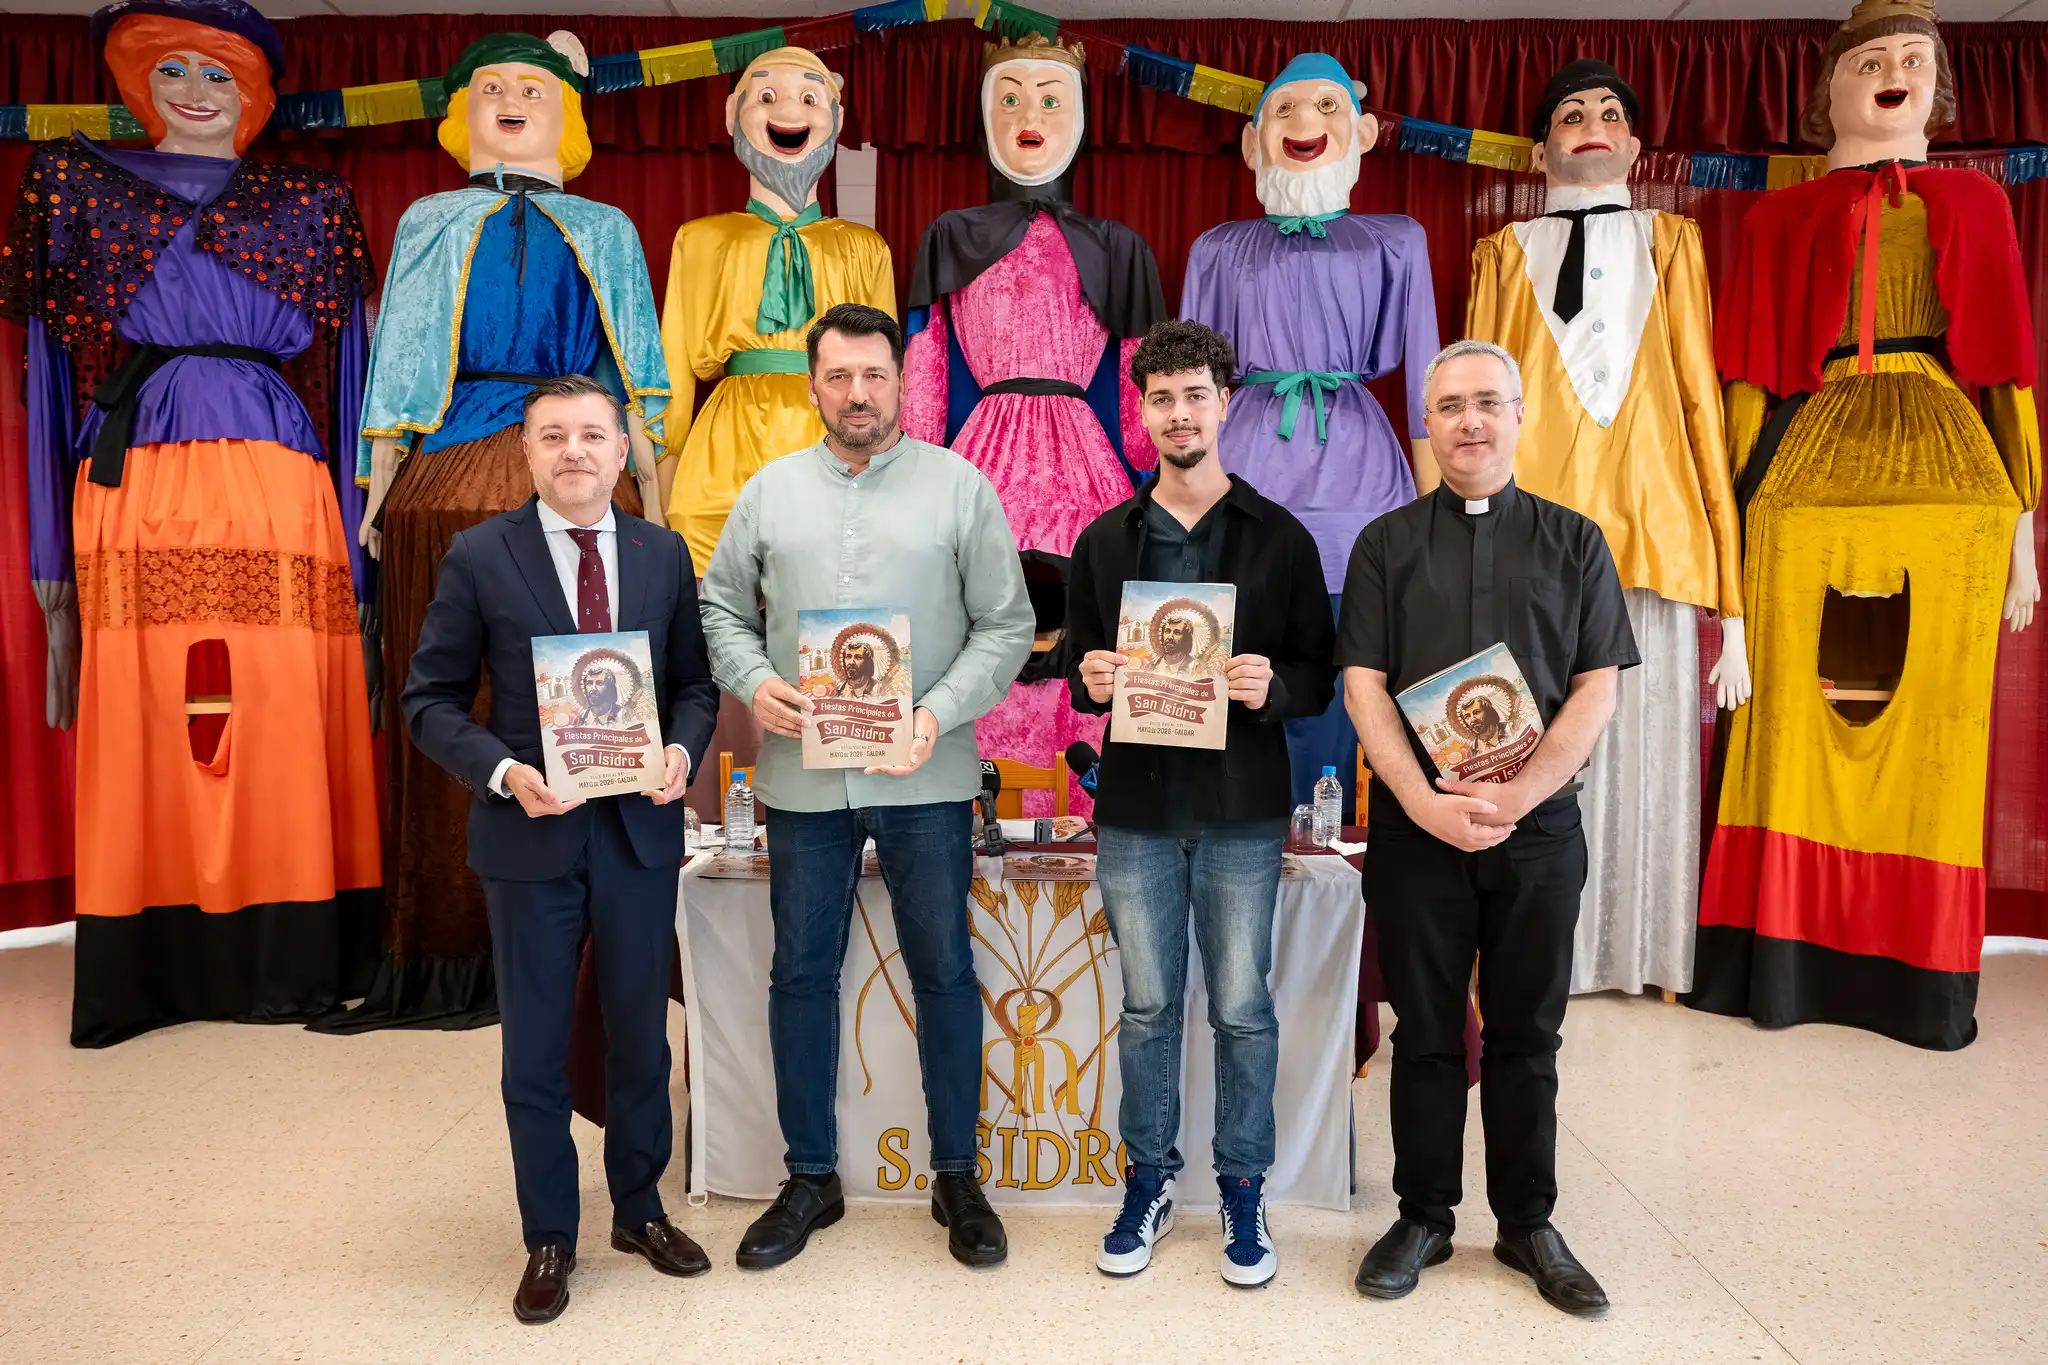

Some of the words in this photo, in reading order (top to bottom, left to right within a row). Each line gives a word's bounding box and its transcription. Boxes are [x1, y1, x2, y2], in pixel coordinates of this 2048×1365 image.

[1133, 675, 1160, 686] Fiestas
[1160, 680, 1200, 696] Principales
[1200, 690, 1209, 698] de
[820, 702, 847, 712] Fiestas
[847, 704, 886, 717] Principales
[887, 710, 895, 718] de
[1134, 696, 1158, 710] San
[1160, 699, 1197, 720] Isidro
[564, 731, 592, 741] Fiestas
[593, 731, 634, 744] Principales
[634, 735, 643, 743] de
[823, 722, 847, 735] San
[850, 723, 886, 741] Isidro
[569, 752, 594, 765] San
[598, 751, 636, 767] Isidro
[1462, 758, 1490, 774] Fiestas
[1490, 741, 1528, 763] Principales
[877, 1127, 929, 1191] S.
